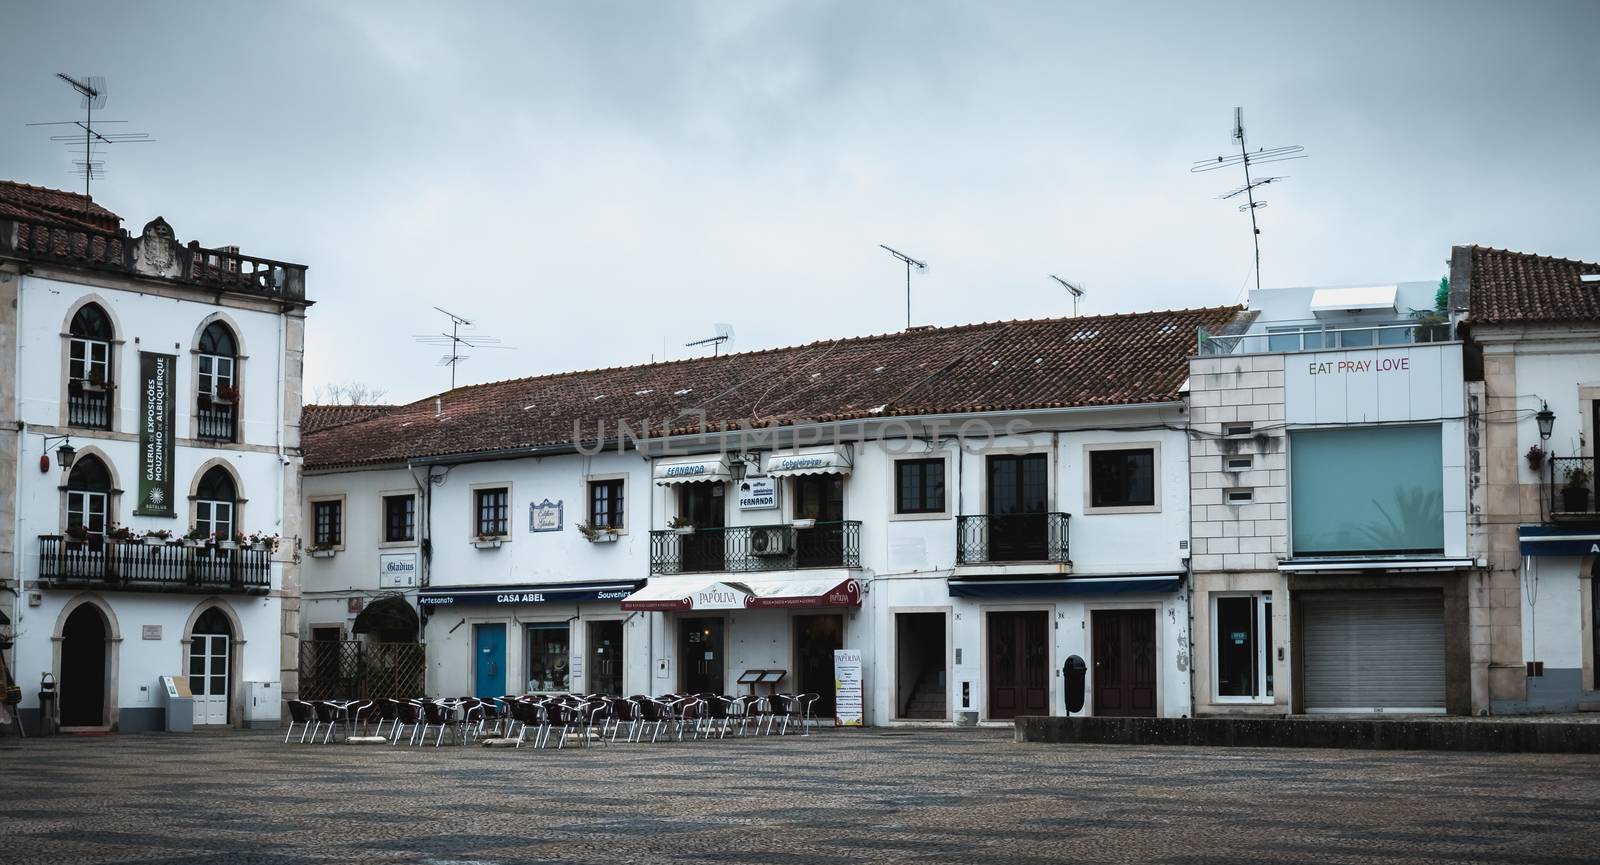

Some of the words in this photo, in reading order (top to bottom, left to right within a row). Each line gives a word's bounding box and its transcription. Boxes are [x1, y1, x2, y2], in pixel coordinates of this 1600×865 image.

[1310, 362, 1334, 375] EAT
[1338, 360, 1372, 374] PRAY
[1376, 358, 1409, 372] LOVE
[156, 358, 164, 422] ALBUQUERQUE
[147, 379, 156, 432] EXPOSIÇÕES
[740, 497, 773, 506] FERNANDA
[386, 562, 414, 572] Gladius
[496, 594, 520, 602] CASA
[522, 594, 544, 602] ABEL
[598, 590, 631, 598] Souvenirs
